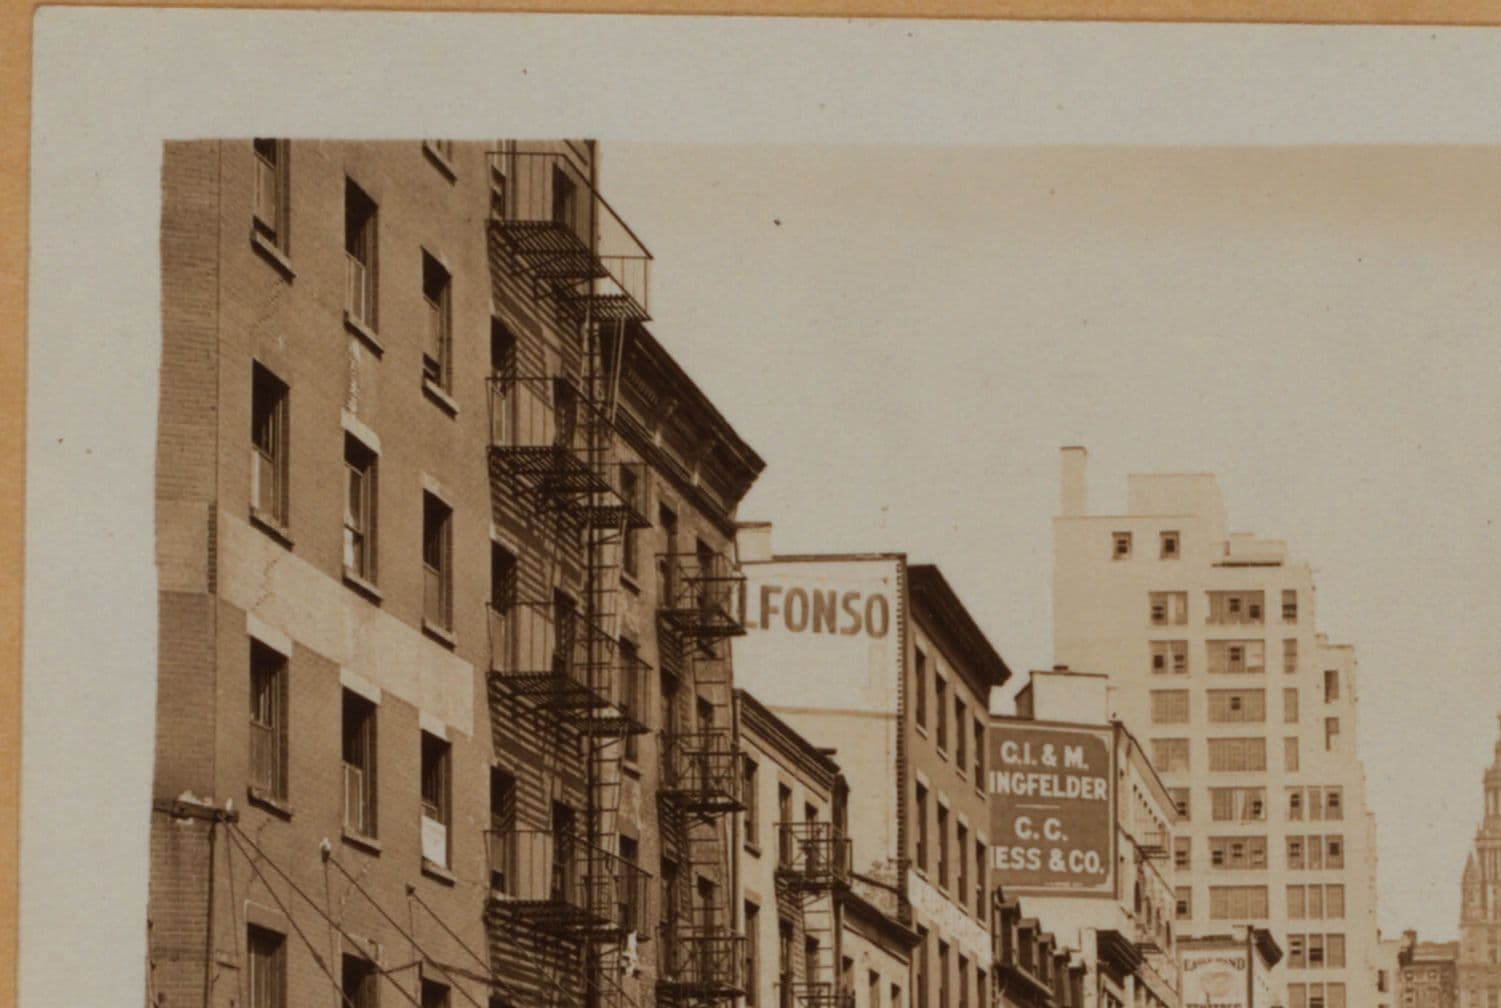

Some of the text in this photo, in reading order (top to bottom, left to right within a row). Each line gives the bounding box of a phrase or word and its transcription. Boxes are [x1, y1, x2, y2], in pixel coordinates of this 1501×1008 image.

[746, 585, 890, 639] FONSO
[1041, 743, 1058, 767] &
[1064, 745, 1090, 770] M.
